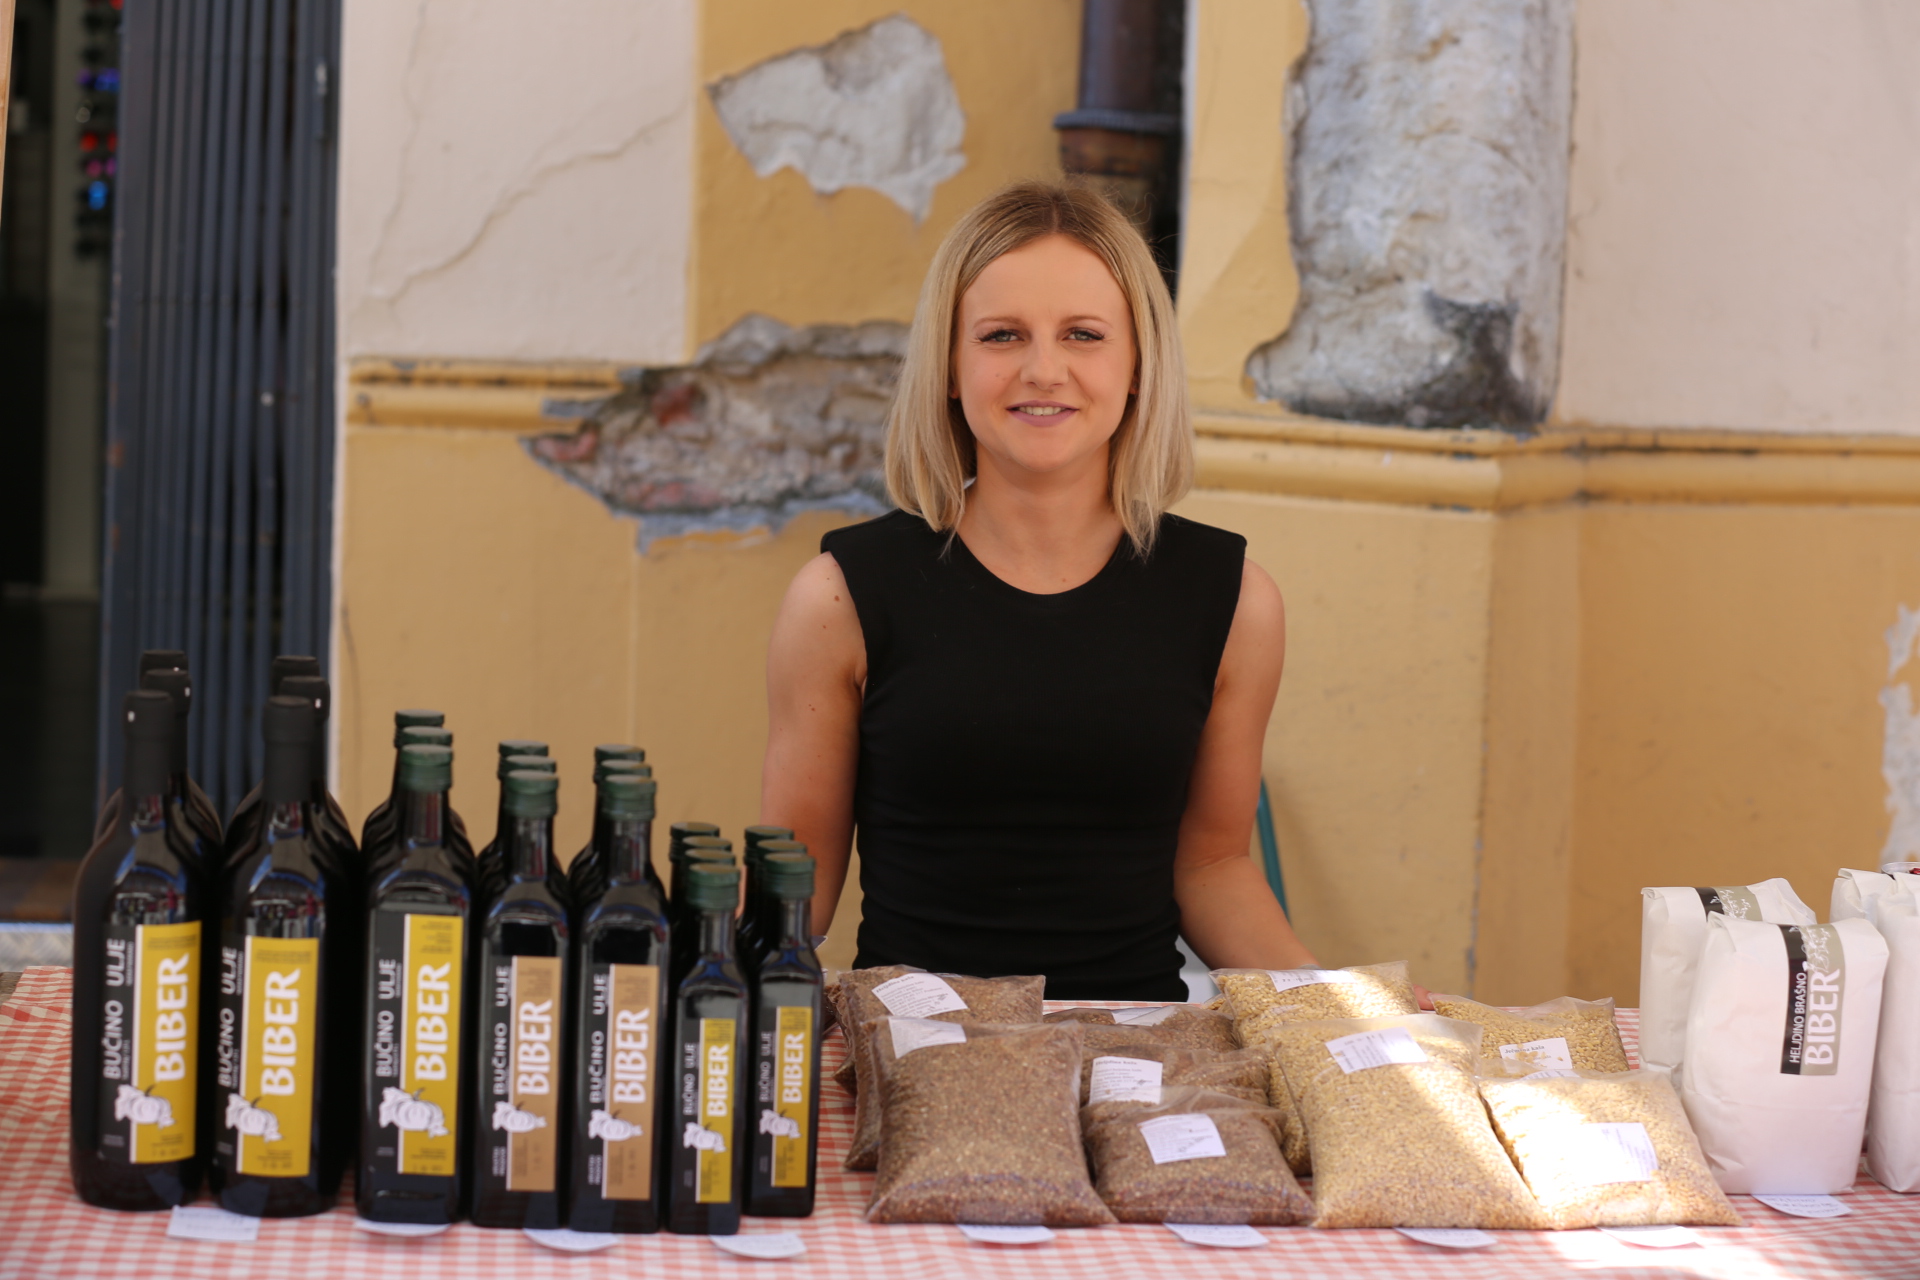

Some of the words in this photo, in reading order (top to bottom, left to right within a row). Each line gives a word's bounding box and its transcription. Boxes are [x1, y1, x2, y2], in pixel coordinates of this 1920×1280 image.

[106, 939, 125, 986] ULJE
[221, 946, 237, 994] ULJE
[378, 959, 396, 999] ULJE
[495, 966, 509, 1007] ULJE
[592, 974, 606, 1015] ULJE
[1794, 972, 1807, 1014] BRAŠNO
[102, 1000, 123, 1079] BUČINO
[154, 953, 189, 1081] BIBER
[217, 1008, 234, 1087] BUČINO
[261, 969, 301, 1096] BIBER
[374, 1011, 394, 1077] BUČINO
[414, 962, 451, 1081] BIBER
[517, 1000, 553, 1095] BIBER
[760, 1031, 772, 1056] ULJE
[1789, 1016, 1805, 1063] HELJDINO
[1804, 969, 1840, 1065] BIBER
[491, 1023, 507, 1095] BUČINO
[588, 1031, 605, 1103] BUČINO
[613, 1008, 650, 1103] BIBER
[684, 1042, 696, 1068] ULJE
[706, 1044, 730, 1117] BIBER
[758, 1061, 771, 1102] BUČINO
[782, 1032, 805, 1103] BIBER
[682, 1074, 695, 1115] BUČINO
